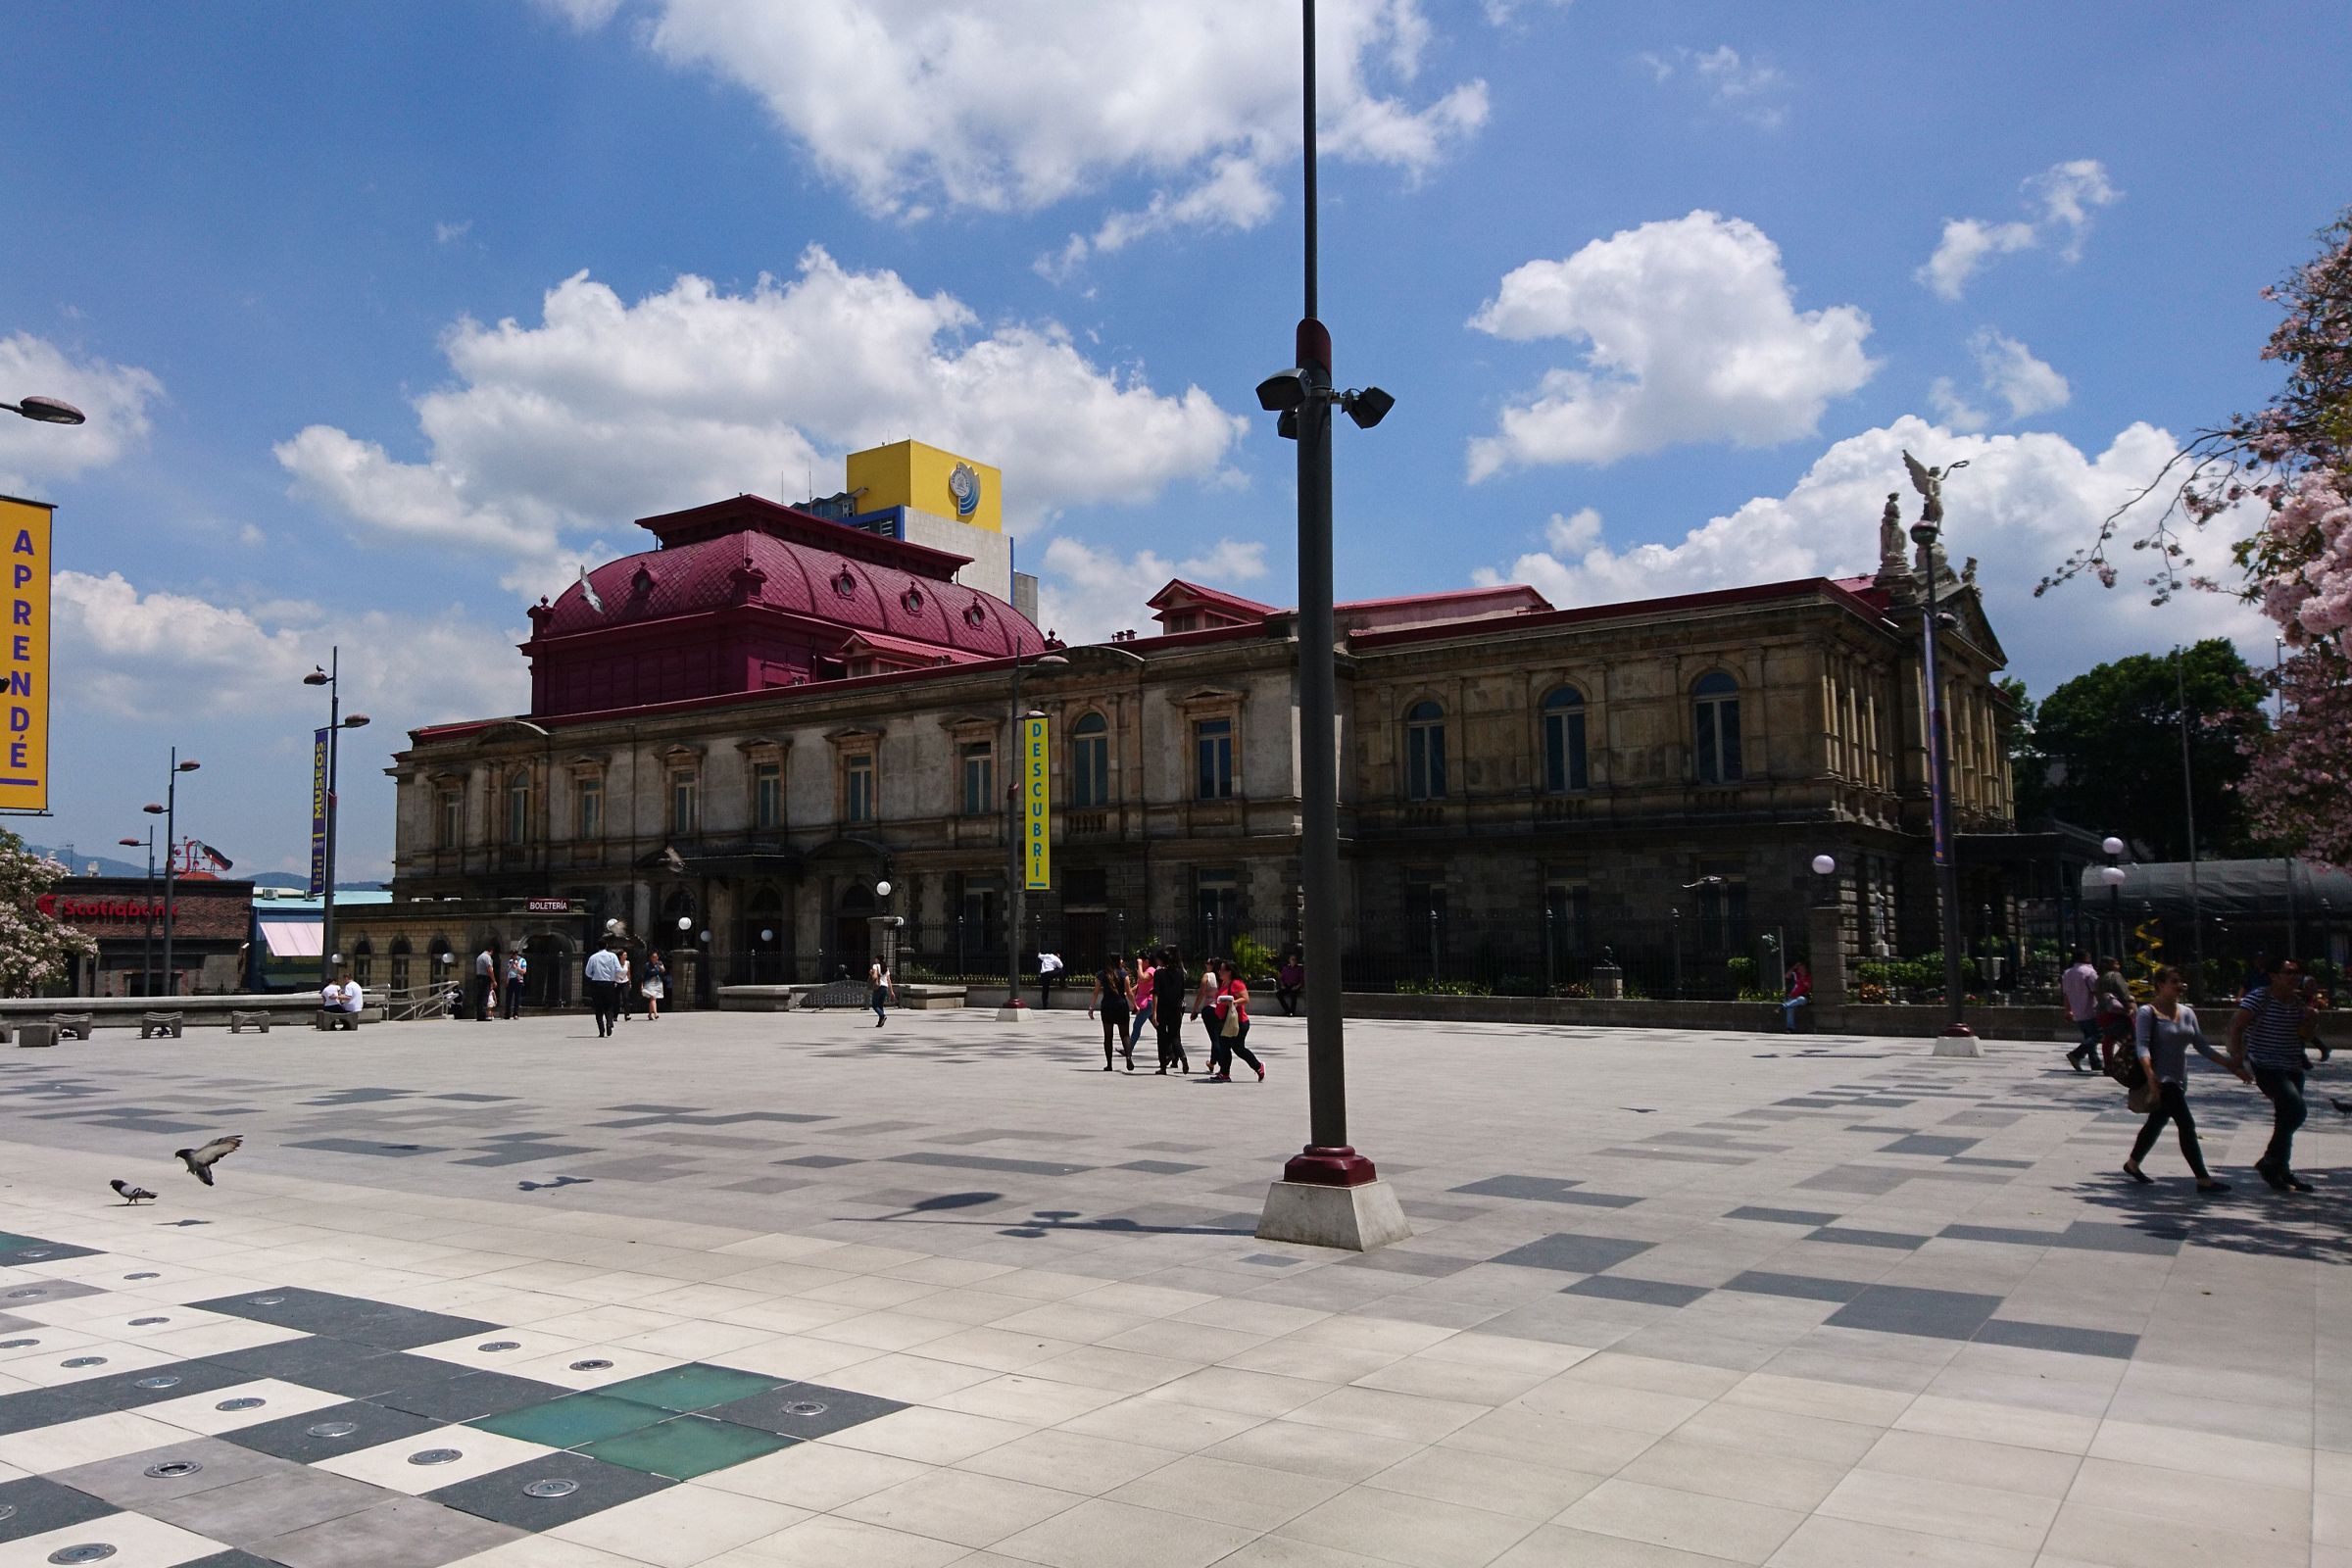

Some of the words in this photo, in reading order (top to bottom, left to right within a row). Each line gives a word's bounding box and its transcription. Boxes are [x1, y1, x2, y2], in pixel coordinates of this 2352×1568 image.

[10, 529, 34, 768] APRENDÉ
[314, 742, 324, 819] MUSEOS
[1032, 723, 1042, 876] DESCUBRÍ
[530, 900, 567, 909] BOLETERÍA
